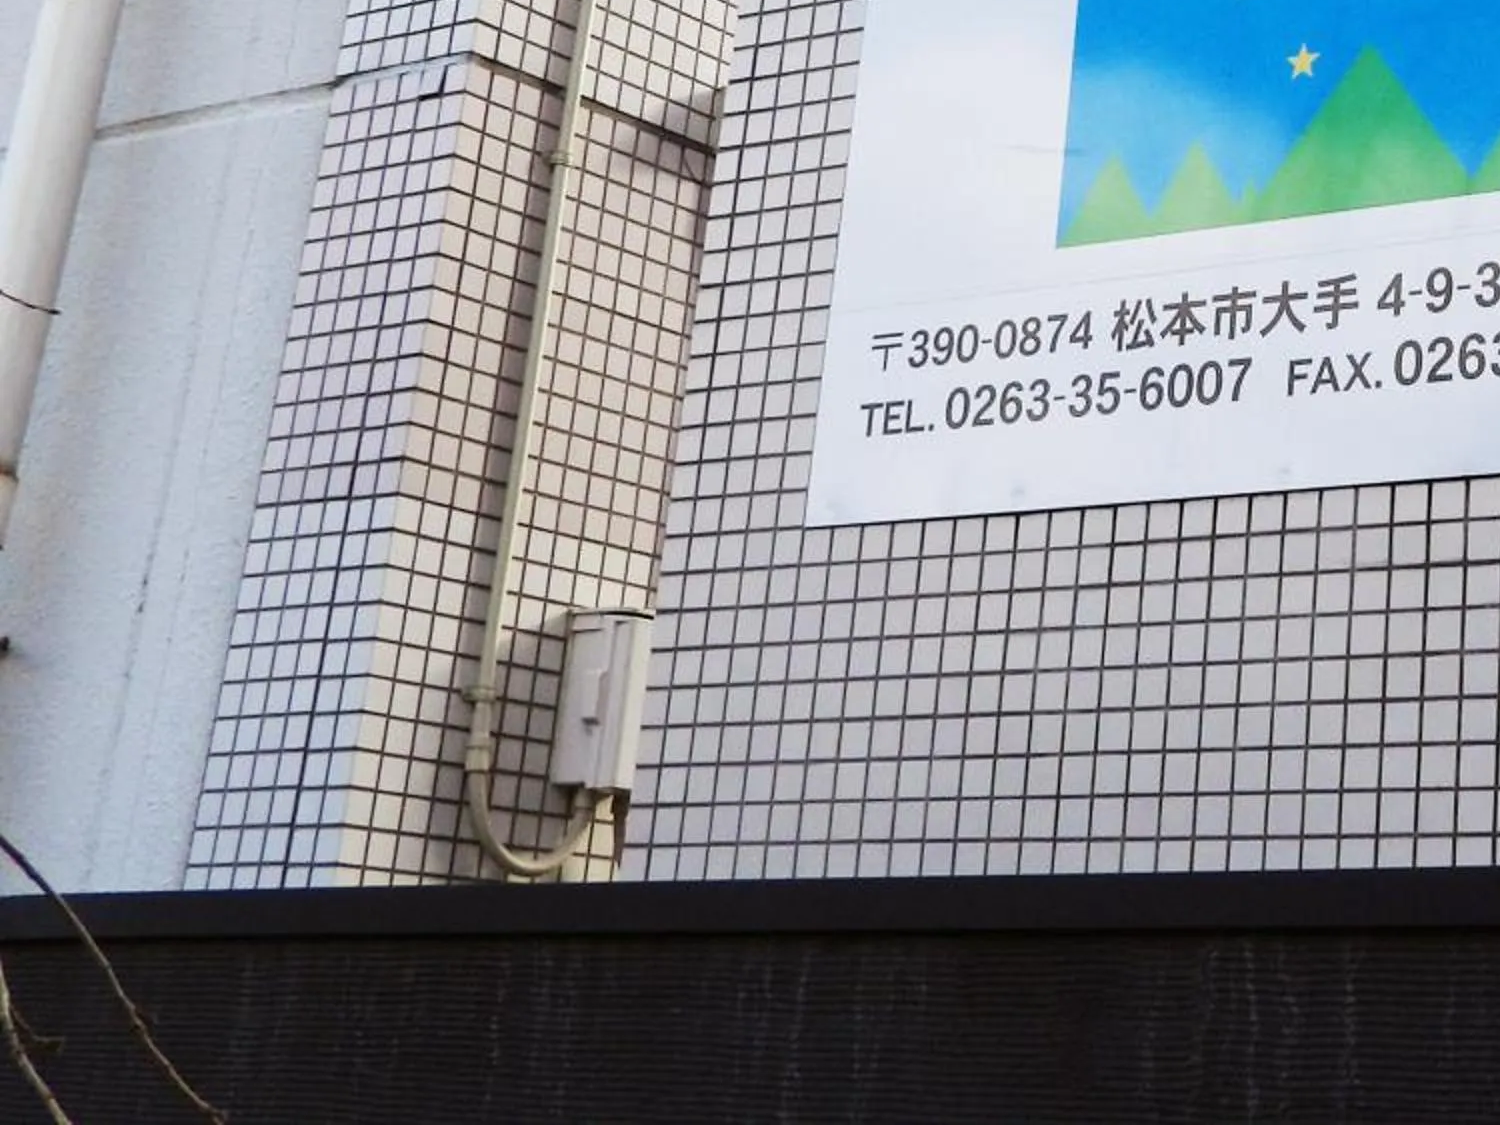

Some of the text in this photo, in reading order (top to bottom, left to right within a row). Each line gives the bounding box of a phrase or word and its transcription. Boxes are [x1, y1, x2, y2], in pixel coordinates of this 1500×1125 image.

[1111, 275, 1360, 353] 松本市大手
